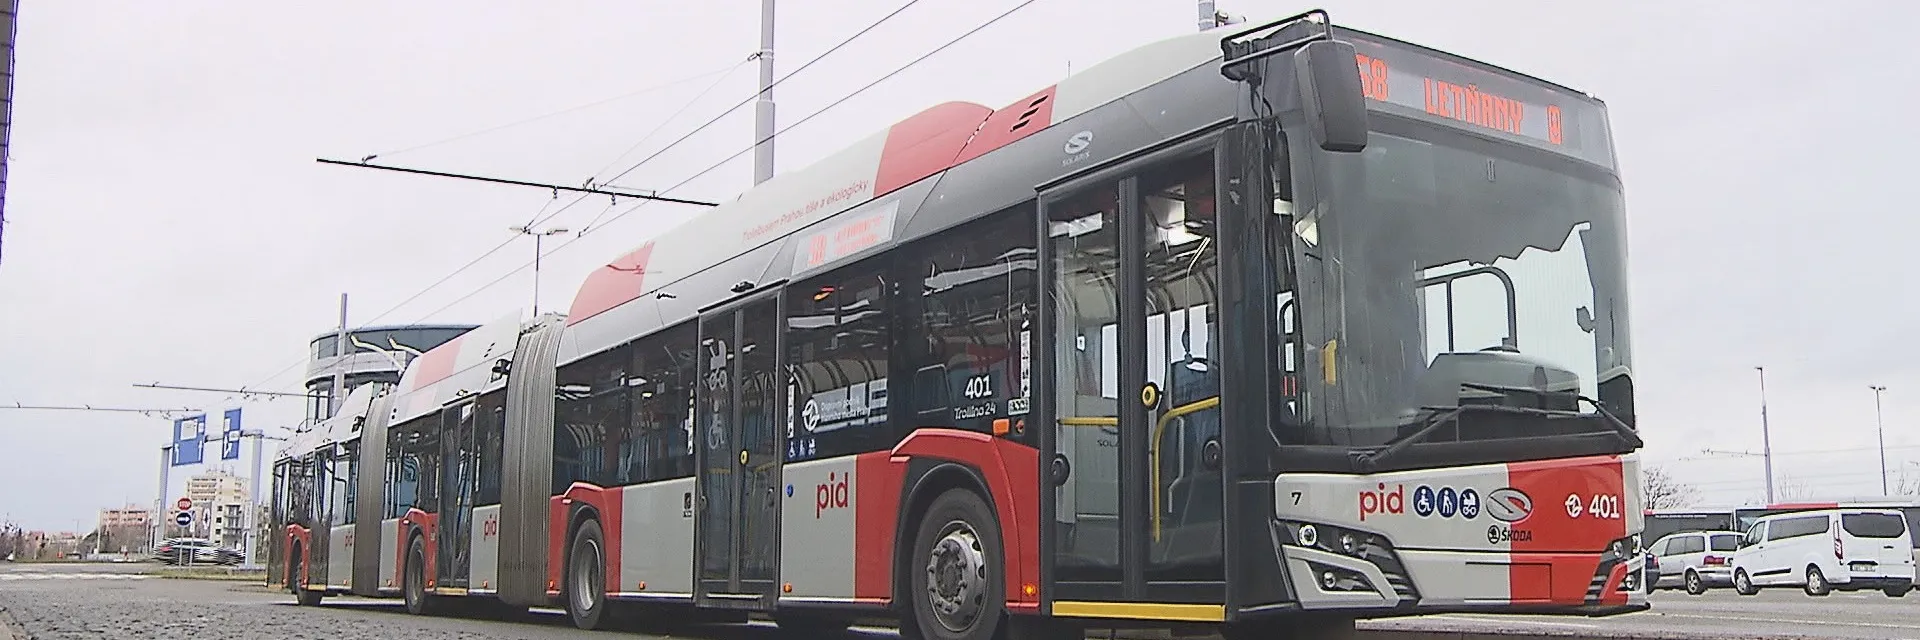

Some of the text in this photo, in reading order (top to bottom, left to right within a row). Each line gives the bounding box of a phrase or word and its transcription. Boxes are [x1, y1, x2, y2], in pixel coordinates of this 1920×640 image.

[1424, 78, 1523, 135] LETŇANY
[965, 374, 993, 400] 401
[954, 402, 997, 420] Trollino 24
[816, 471, 849, 519] pid
[1291, 491, 1302, 506] 7
[1359, 482, 1404, 521] pid
[1588, 494, 1620, 519] 401
[483, 513, 497, 542] pid
[1501, 527, 1533, 542] ŠKODA
